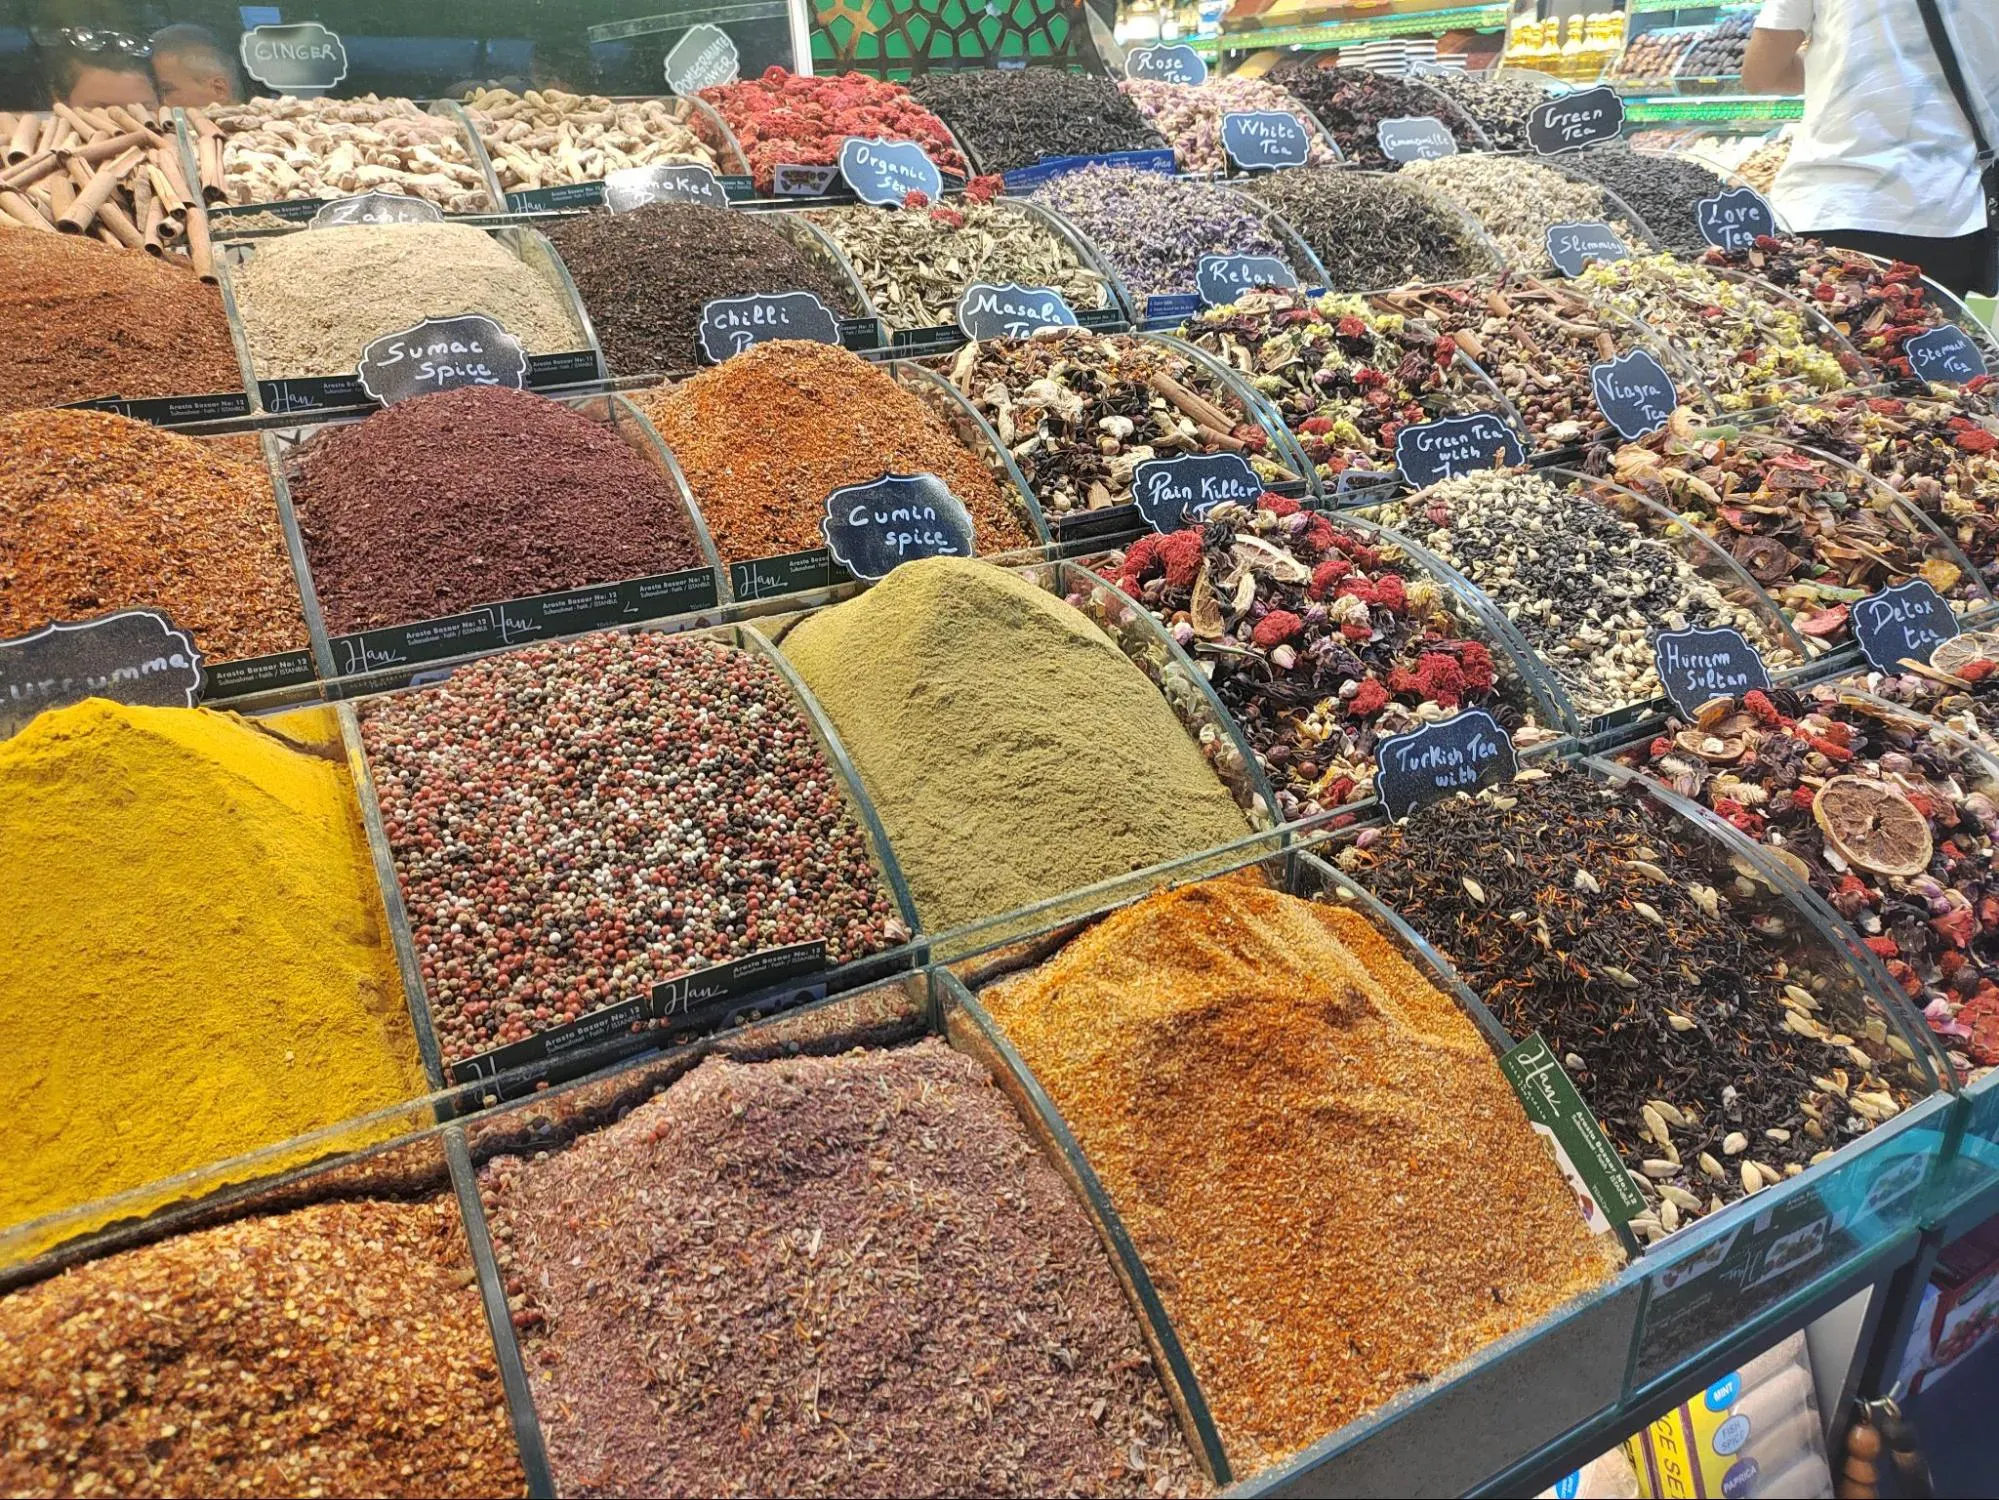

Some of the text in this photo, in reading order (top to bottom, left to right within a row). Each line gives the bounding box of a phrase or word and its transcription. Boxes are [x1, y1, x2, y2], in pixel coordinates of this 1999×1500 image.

[1137, 52, 1183, 71] Rose
[1164, 71, 1192, 83] Tea
[1238, 119, 1295, 139] White
[1544, 107, 1603, 129] Green
[1562, 124, 1596, 141] Tea
[1260, 140, 1293, 155] Tea
[1417, 146, 1442, 158] Tea
[856, 146, 927, 181] Organic
[1707, 203, 1760, 225] Love
[1717, 225, 1753, 250] Tea
[1210, 260, 1276, 285] Relax
[967, 294, 1063, 325] Masala
[1003, 321, 1031, 339] Te
[377, 341, 483, 366] Sumac
[1943, 355, 1973, 373] Tea
[268, 381, 323, 413] Han
[1597, 373, 1661, 406] Viagra
[1641, 404, 1671, 421] Tea
[1416, 424, 1503, 451] Green Tea
[1439, 446, 1480, 461] with
[1148, 471, 1258, 506] Pain Killer
[849, 504, 936, 527] Cumin
[738, 563, 788, 599] Han
[1868, 597, 1934, 636] Detox
[340, 637, 407, 674] Han
[1686, 670, 1748, 691] Sultan
[1396, 733, 1498, 772] Turkish Tea
[1435, 765, 1477, 787] with
[664, 978, 728, 1016] Han
[1515, 1043, 1561, 1118] Han
[1576, 1112, 1596, 1140] Arasta
[1713, 1381, 1734, 1402] MINT
[1722, 1420, 1741, 1438] FISH
